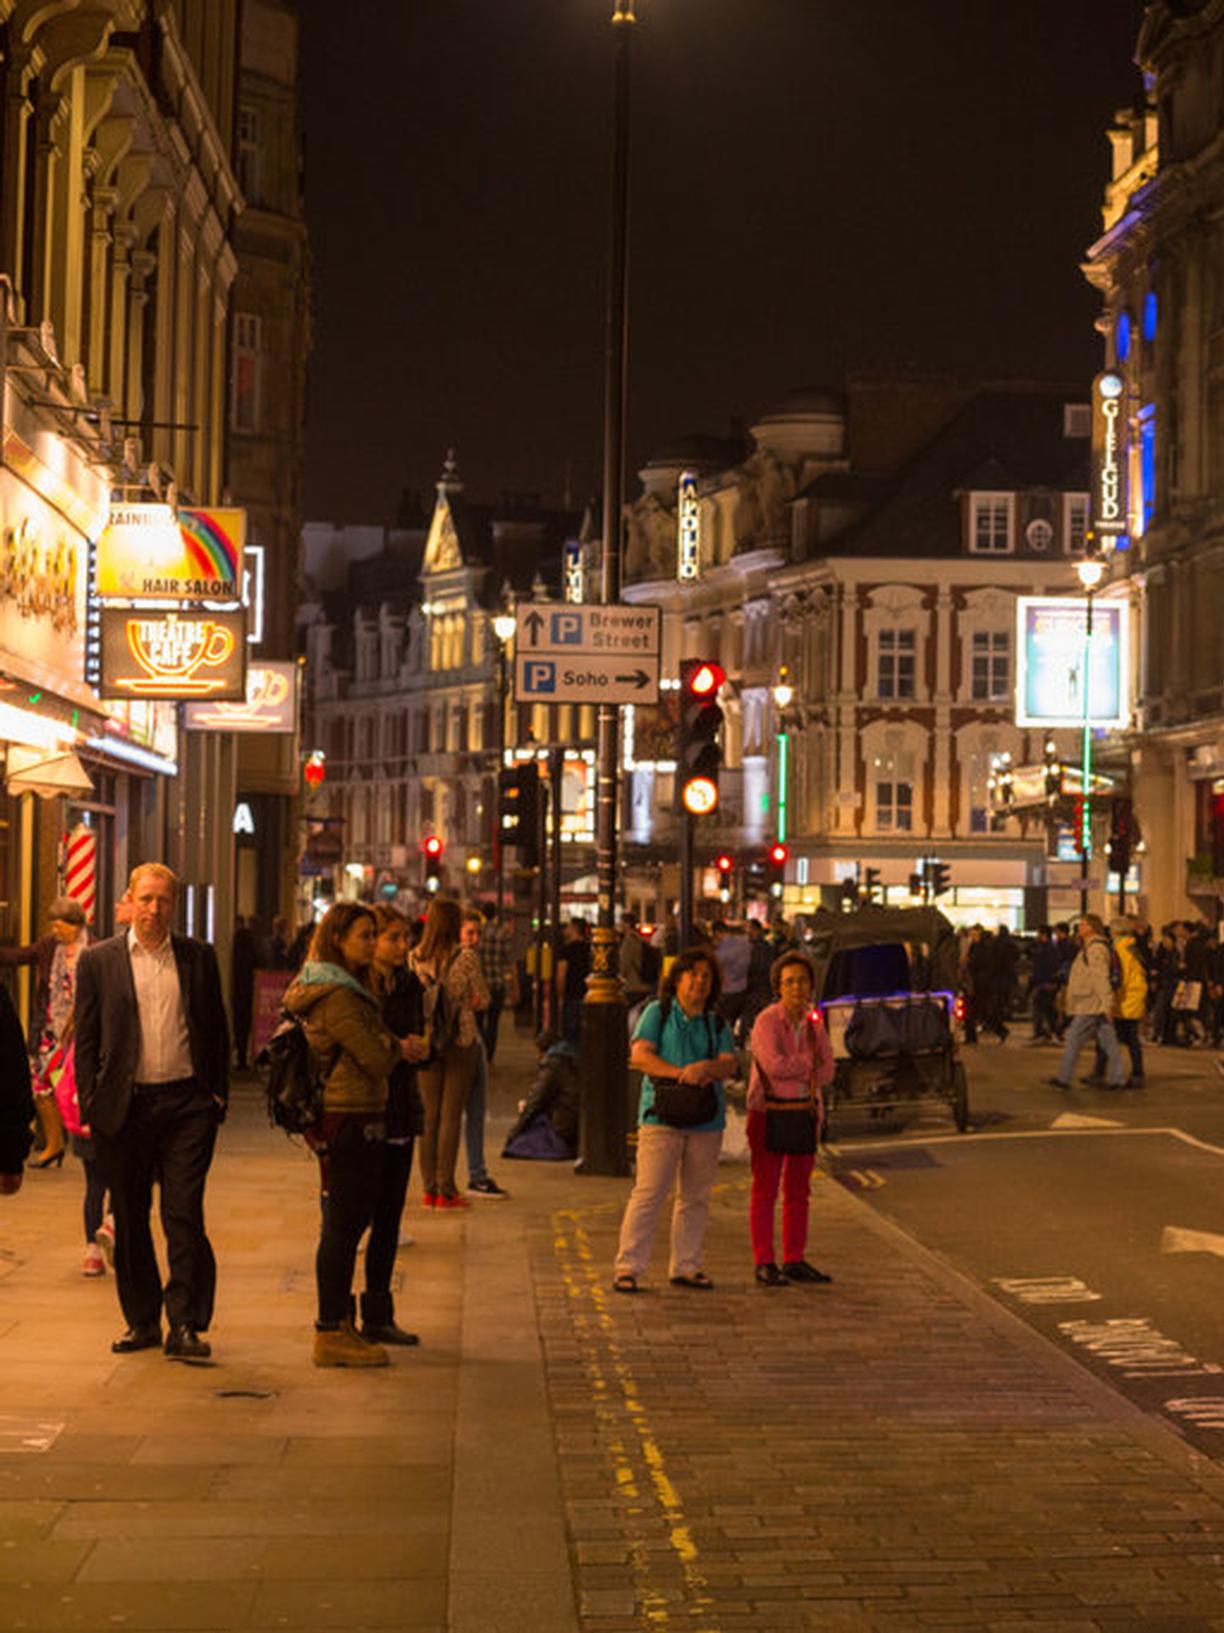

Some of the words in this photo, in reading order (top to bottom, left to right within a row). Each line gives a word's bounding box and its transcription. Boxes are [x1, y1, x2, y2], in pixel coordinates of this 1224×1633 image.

[1101, 399, 1119, 519] GIELGUD
[143, 579, 179, 593] HAIR
[185, 579, 234, 595] SALON
[558, 616, 578, 643] P
[589, 612, 654, 628] Brewer
[592, 632, 650, 648] Street
[530, 664, 550, 691] P
[563, 669, 609, 686] Soho
